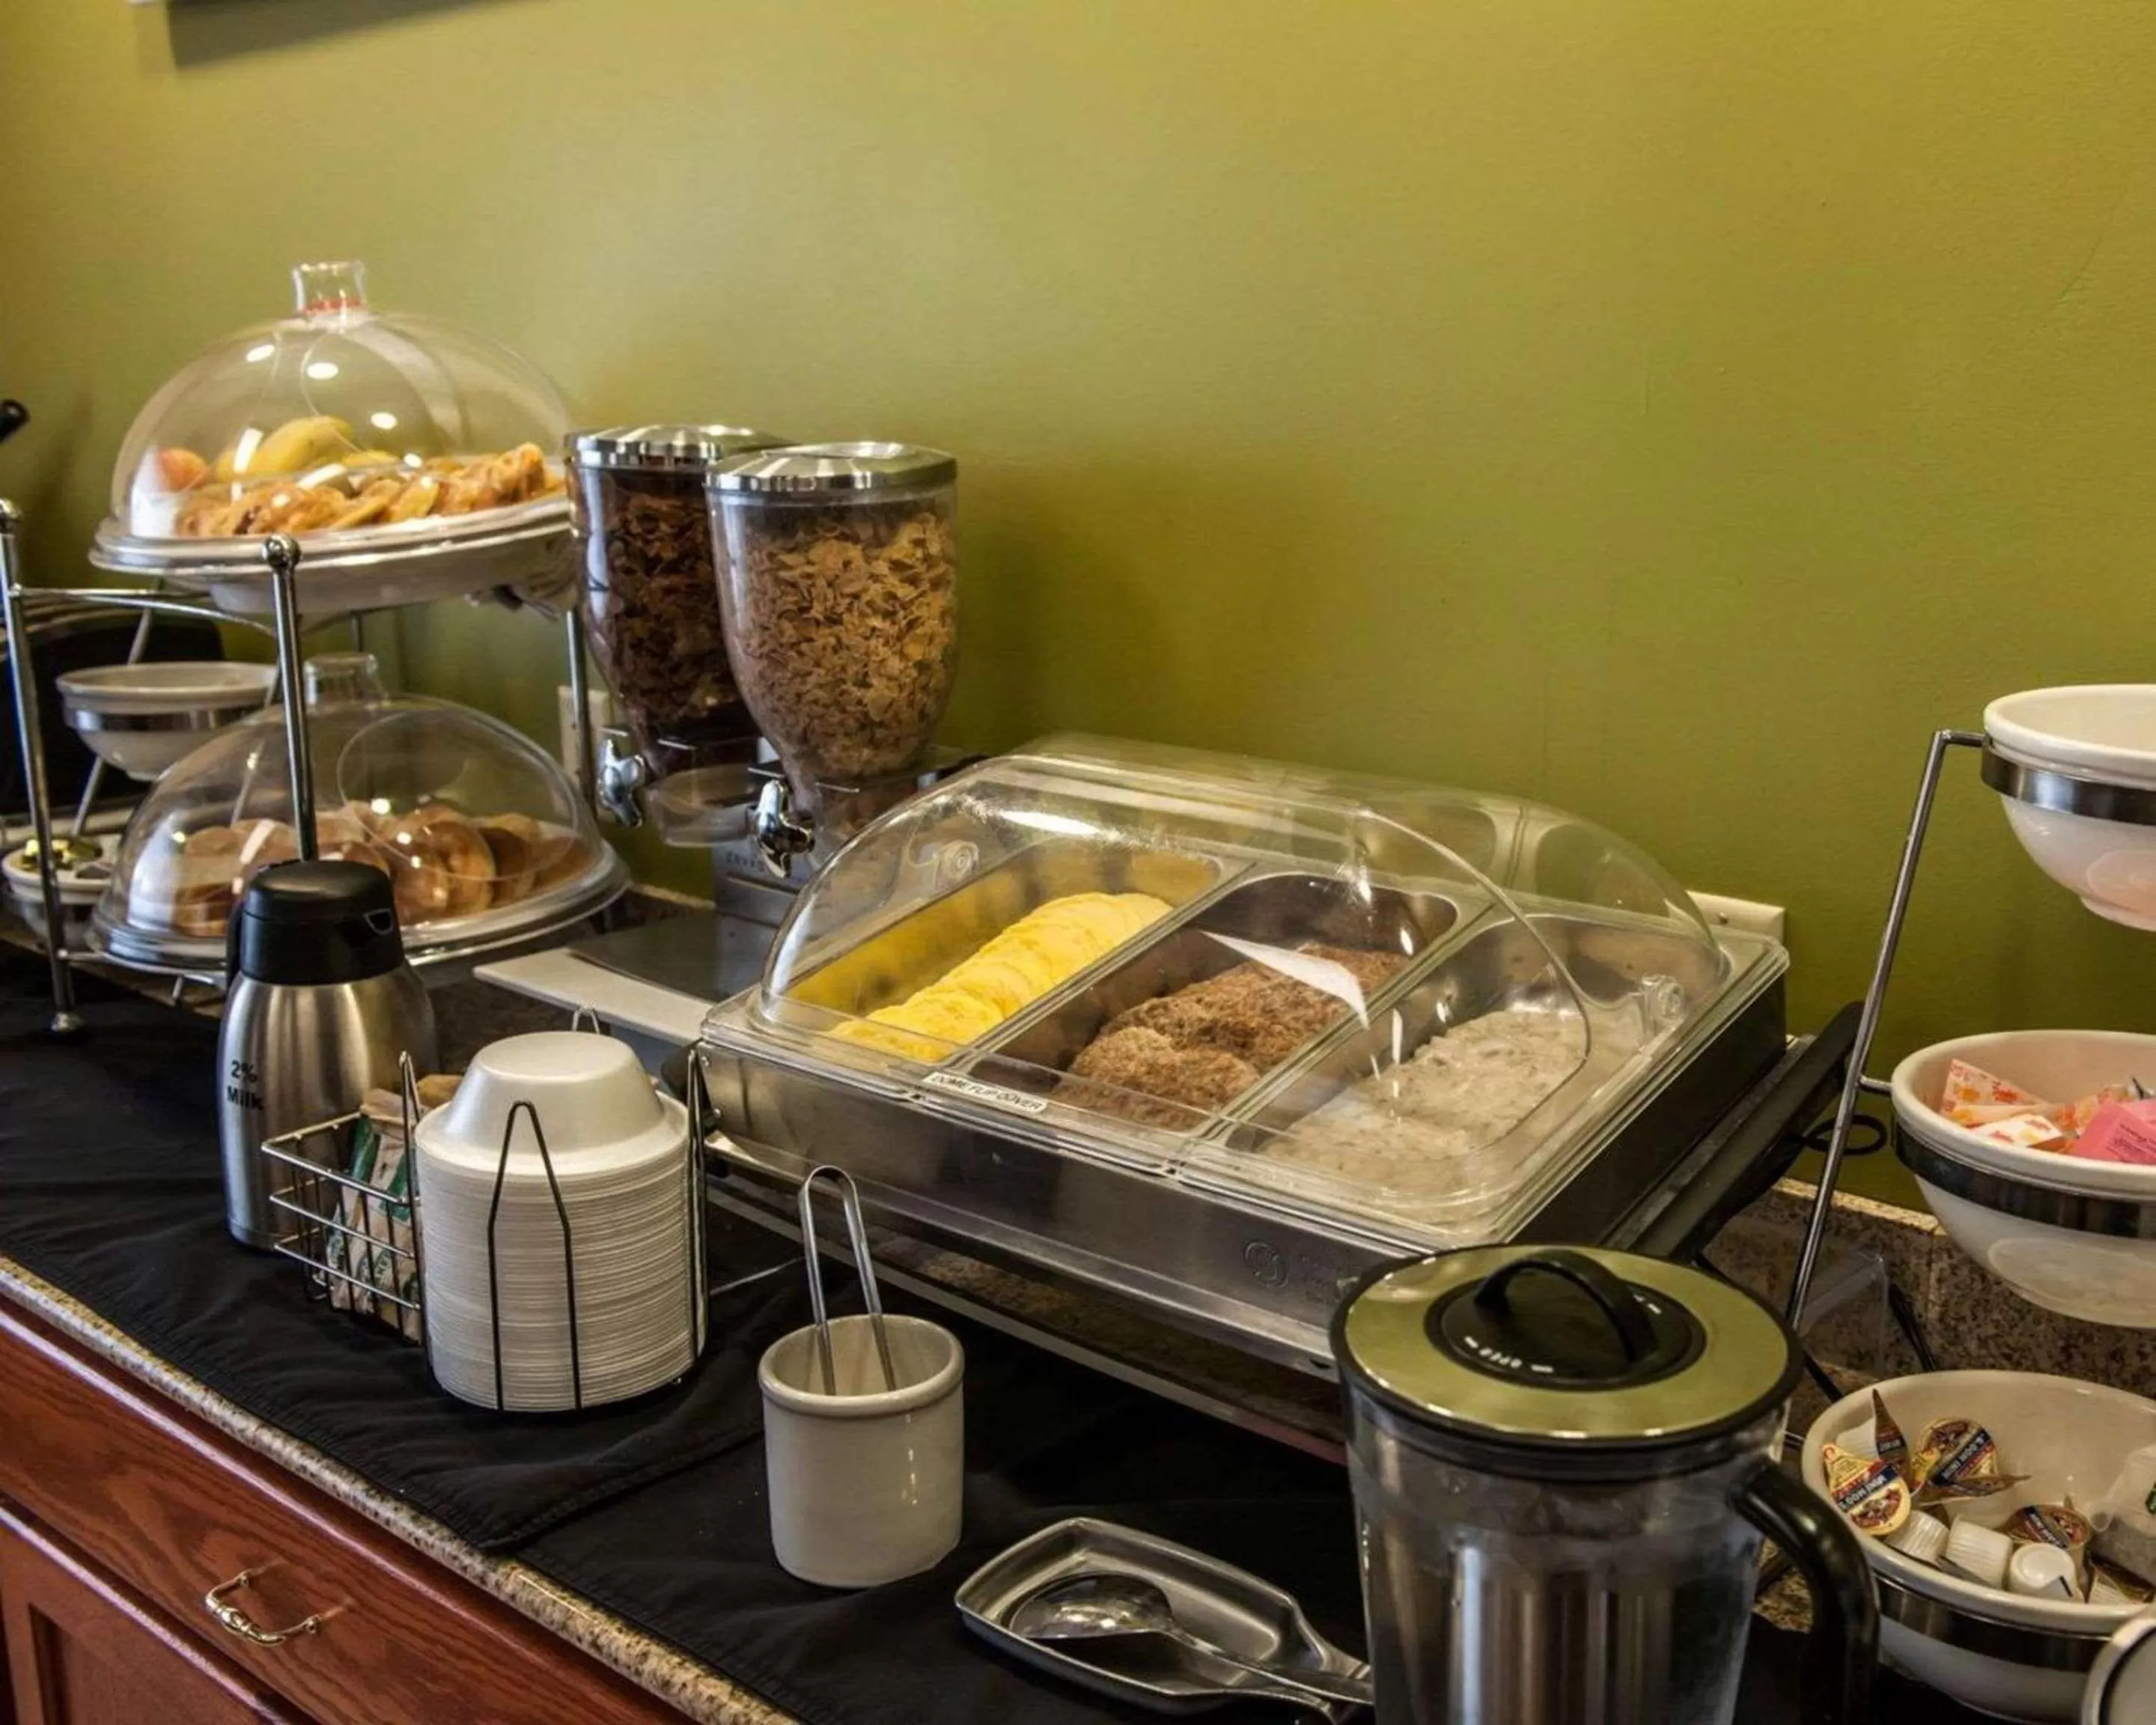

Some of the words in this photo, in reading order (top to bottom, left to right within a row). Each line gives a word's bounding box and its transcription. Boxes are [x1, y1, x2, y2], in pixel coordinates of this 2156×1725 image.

[231, 1059, 258, 1083] 2%
[227, 1085, 264, 1112] Milk
[996, 1092, 1044, 1110] COVER
